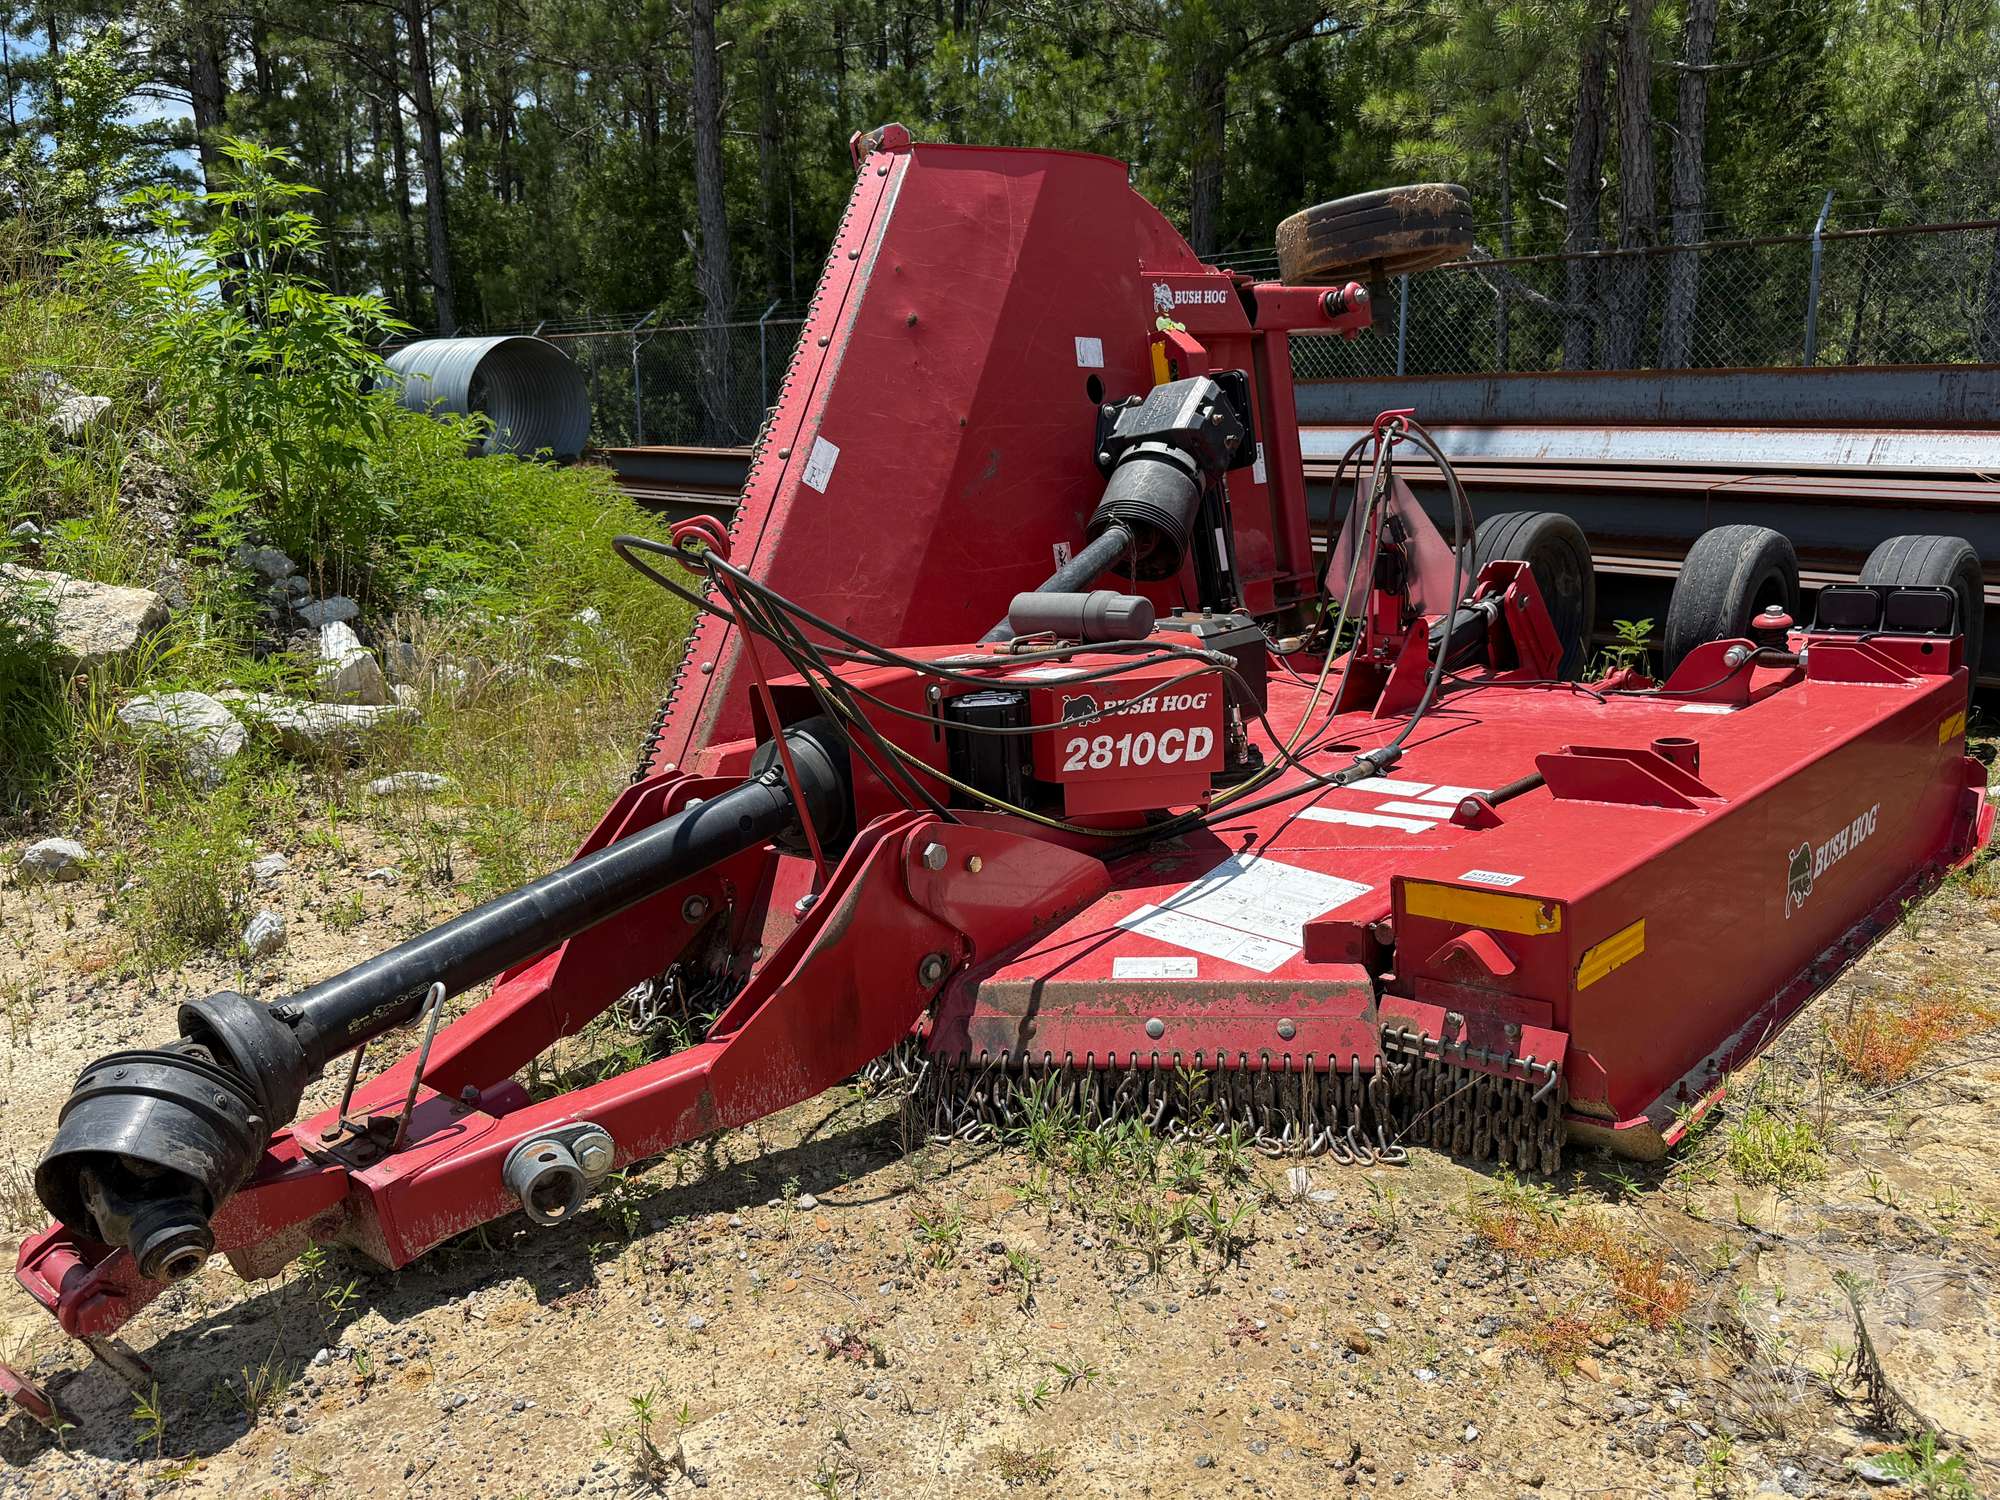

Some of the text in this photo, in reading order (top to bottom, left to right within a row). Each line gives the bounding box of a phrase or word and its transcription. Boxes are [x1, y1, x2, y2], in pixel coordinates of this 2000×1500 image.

[1175, 290, 1226, 304] BUSH HOG
[1161, 693, 1208, 712] HOG
[1063, 727, 1214, 772] 2810CD
[1813, 804, 1878, 879] BUSH HOG
